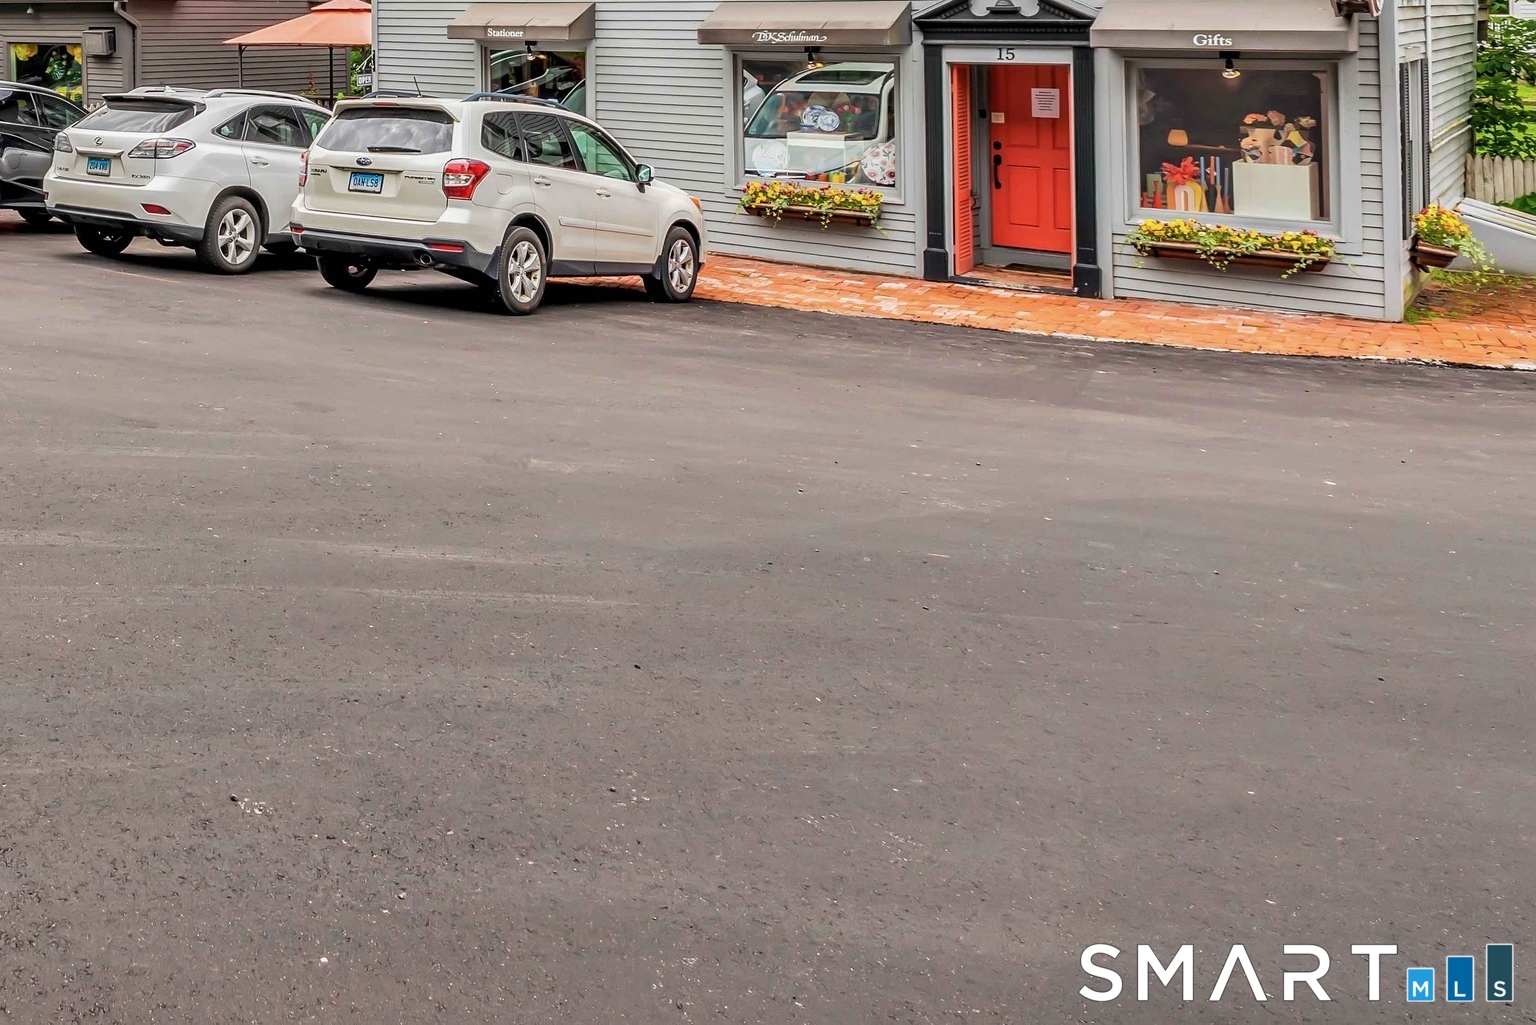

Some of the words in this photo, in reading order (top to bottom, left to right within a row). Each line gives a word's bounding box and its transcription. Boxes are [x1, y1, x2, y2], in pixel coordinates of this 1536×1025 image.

[487, 28, 524, 37] Stationer
[1193, 34, 1233, 46] Gifts
[997, 48, 1015, 61] 15
[358, 76, 372, 85] OPEN
